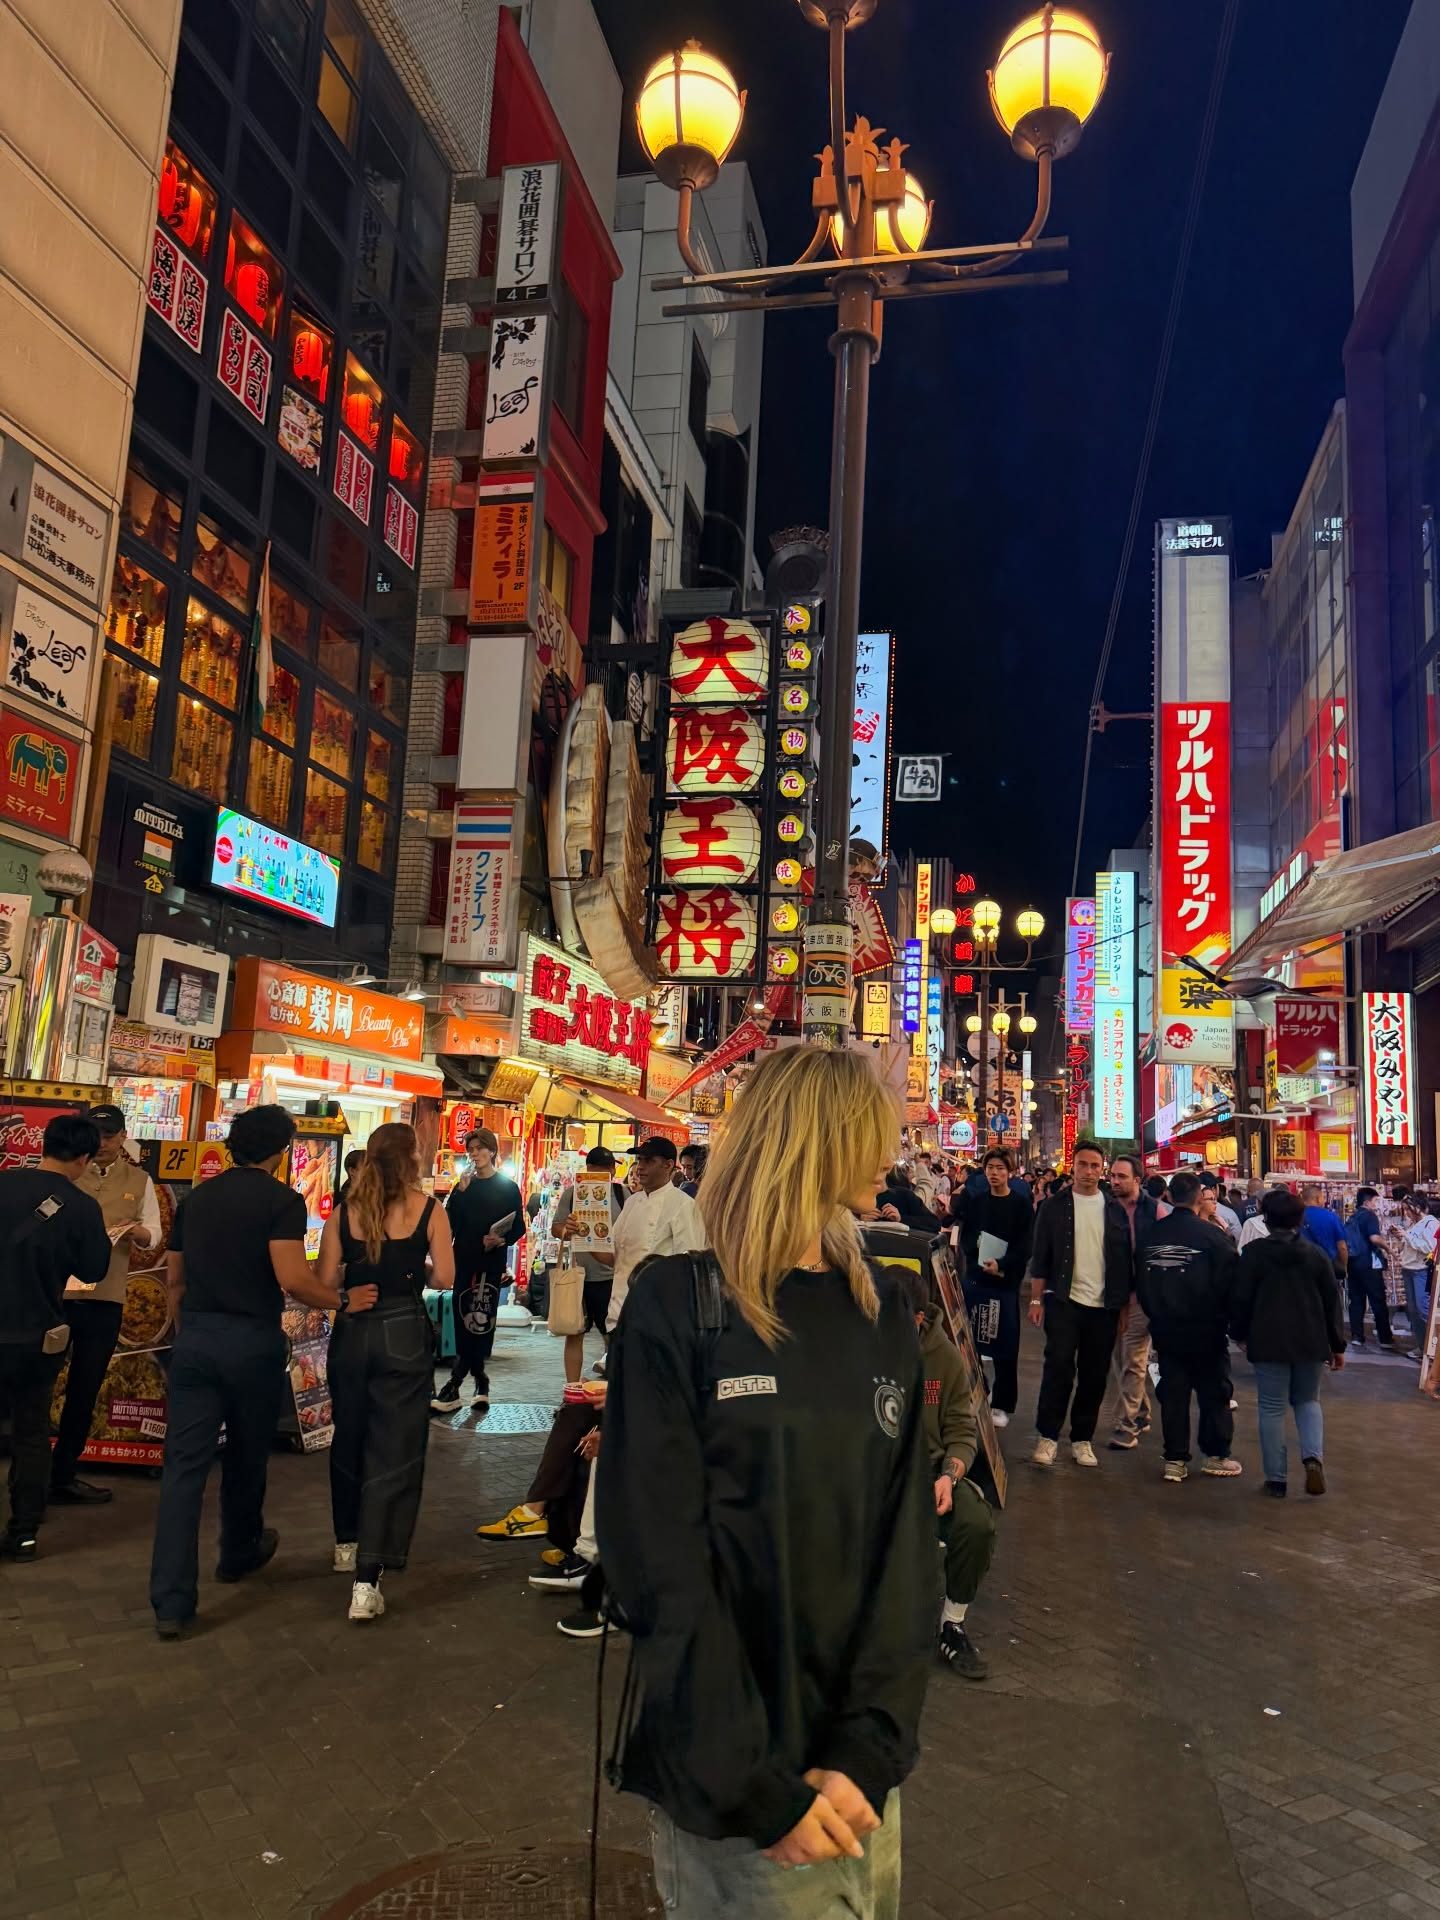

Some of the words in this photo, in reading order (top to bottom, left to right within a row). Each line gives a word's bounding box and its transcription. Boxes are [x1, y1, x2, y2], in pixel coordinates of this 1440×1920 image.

[514, 168, 543, 285] 浪花囲碁サロン
[151, 237, 176, 311] 海鮮
[177, 268, 202, 343] 浜焼
[226, 320, 244, 386] 串カツ
[247, 349, 267, 413] 寿司
[486, 376, 538, 424] Leaf
[32, 482, 104, 541] 浪花囲碁サロン
[492, 506, 515, 600] ミティラー
[1165, 538, 1225, 550] 法善寺ビル
[38, 630, 87, 674] Leaf
[5, 794, 57, 823] ミティラー
[655, 616, 769, 975] 大阪王将
[1175, 709, 1216, 932] ツルハドラッグ
[148, 878, 160, 891] 2F
[471, 851, 491, 932] クンテープ
[918, 871, 930, 925] ジャンカラ
[488, 947, 498, 956] B1
[267, 978, 308, 1009] 心斎橋
[1076, 928, 1095, 1023] ジャンカラ
[269, 1006, 302, 1026] 処方せん
[308, 984, 354, 1040] 薬局
[353, 1005, 393, 1042] Beauty
[566, 983, 653, 1072] 大阪王将
[805, 1004, 848, 1020] 大阪市
[869, 1006, 885, 1033] 焼肉
[1278, 1003, 1337, 1021] ツルハ
[1279, 1023, 1326, 1036] ドラッグ
[121, 1034, 146, 1049] Food
[1113, 1018, 1124, 1062] カラオケ
[1211, 1041, 1231, 1051] Shop
[1373, 1002, 1408, 1135] 大阪みやげ
[456, 1109, 473, 1146] 餃子
[1276, 1133, 1296, 1157] 薬
[165, 1148, 189, 1171] 2F
[719, 1377, 773, 1397] CLTR
[112, 1404, 139, 1416] MUTTON
[138, 1406, 164, 1417] BIRYANI
[101, 1446, 146, 1459] おもちかえり
[147, 1449, 161, 1459] OK
